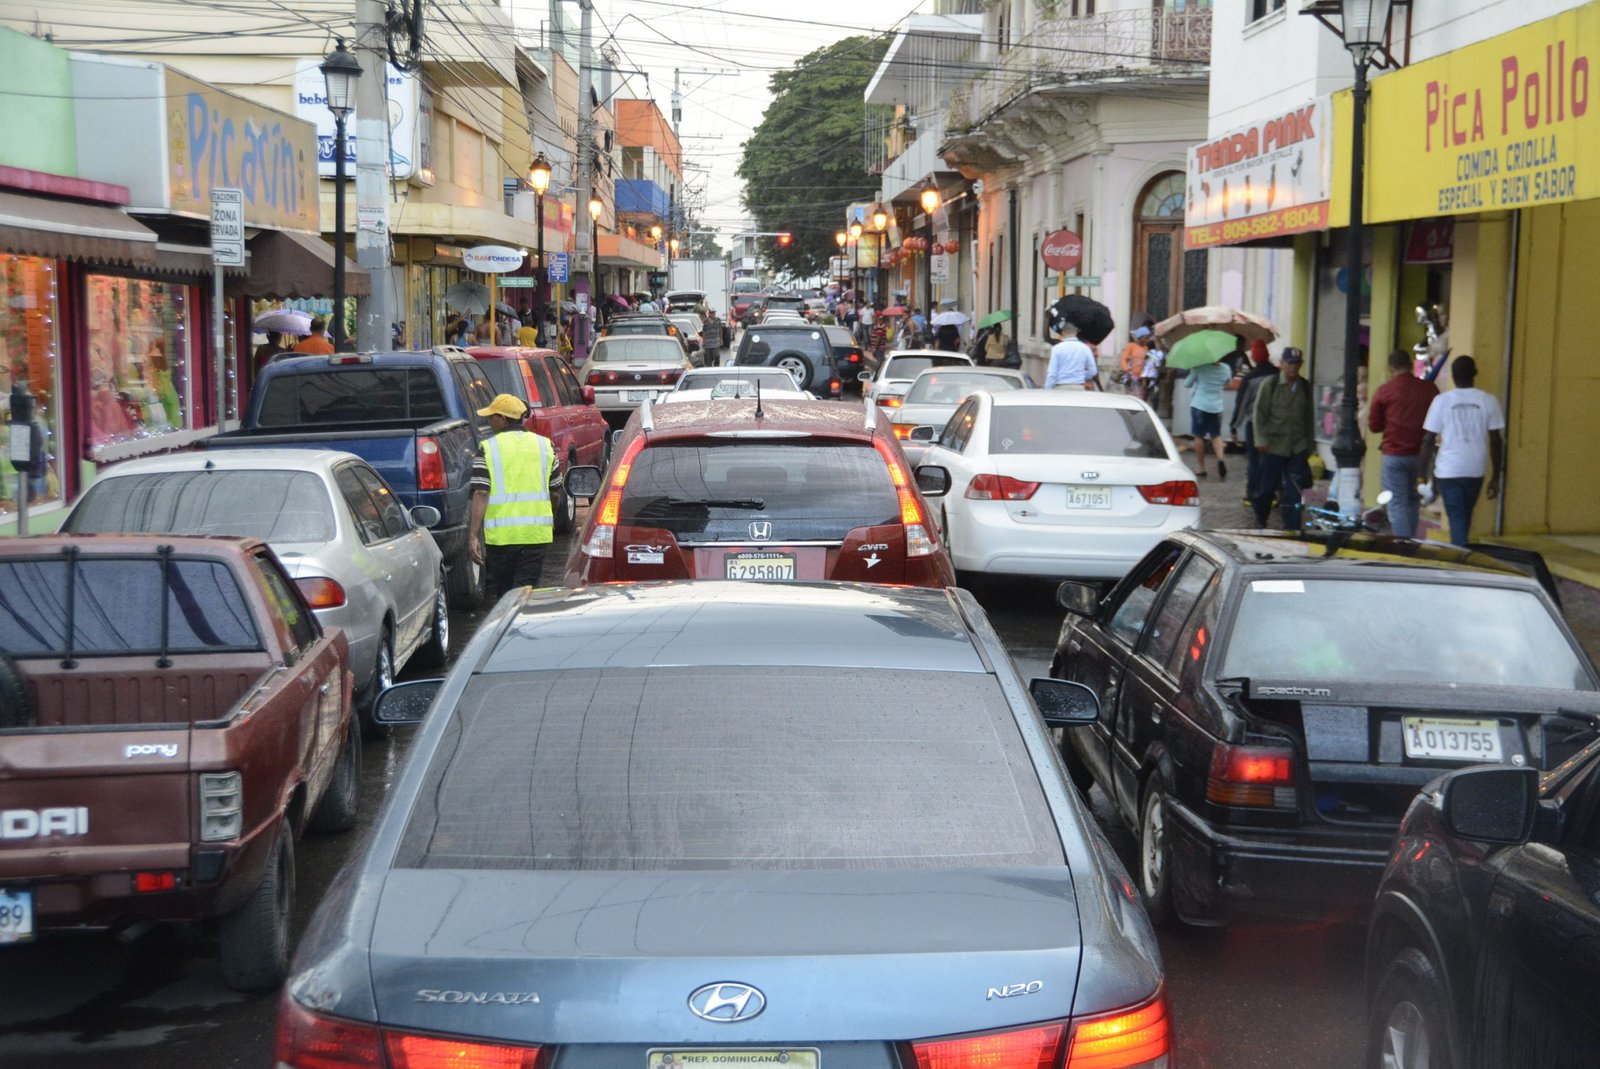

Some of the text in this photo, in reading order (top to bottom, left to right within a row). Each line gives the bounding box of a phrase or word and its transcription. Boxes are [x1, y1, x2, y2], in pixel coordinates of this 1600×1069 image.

[1502, 40, 1588, 136] Pollo
[1262, 103, 1316, 154] PINK
[1457, 134, 1557, 182] COMIDA CRIOLLA
[1438, 165, 1575, 211] ESPECIAL Y BUEN SABOR
[215, 209, 237, 222] ZONA
[1223, 206, 1320, 240] 809-582-1804
[1044, 243, 1081, 257] Coca-Cola
[1069, 494, 1109, 505] A671051
[729, 565, 792, 580] G295807
[1258, 686, 1331, 697] spectrum
[1412, 729, 1494, 751] A013755
[126, 743, 178, 759] pony
[0, 807, 89, 839] DAI
[415, 989, 540, 1004] SONATA
[712, 1055, 780, 1064] DOMINICANA
